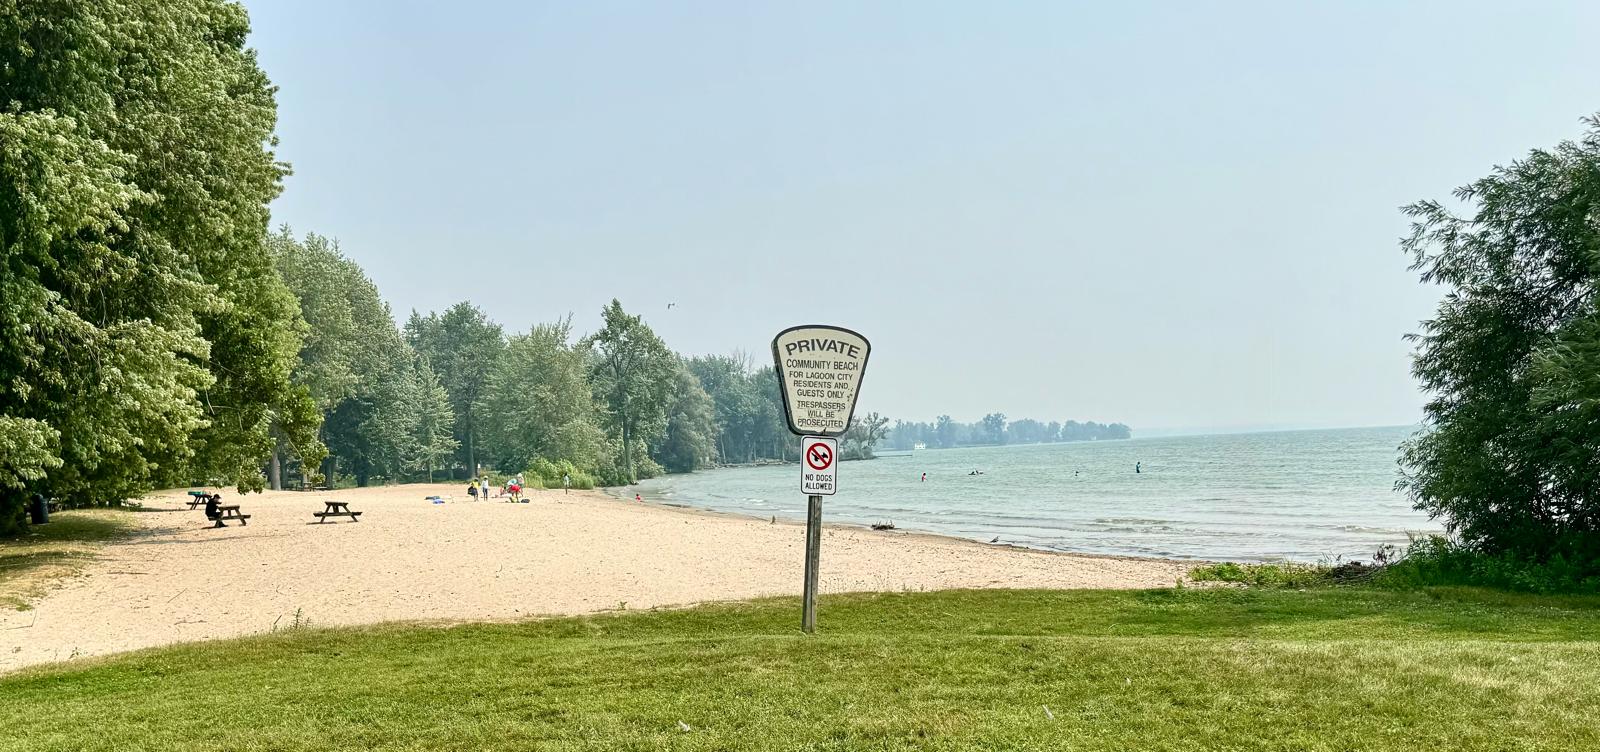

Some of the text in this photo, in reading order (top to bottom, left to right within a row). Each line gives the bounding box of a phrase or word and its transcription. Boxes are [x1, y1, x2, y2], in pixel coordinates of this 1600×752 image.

[786, 338, 860, 359] PRIVATE
[786, 359, 858, 370] COMMUNITY BEACH
[806, 372, 834, 380] LAGOON
[794, 380, 832, 388] RESIDENTS
[797, 389, 824, 398] GUESTS
[797, 401, 845, 410] TRESPASSERS
[798, 419, 843, 427] PROSECUTED
[805, 482, 832, 490] ALLOWED
